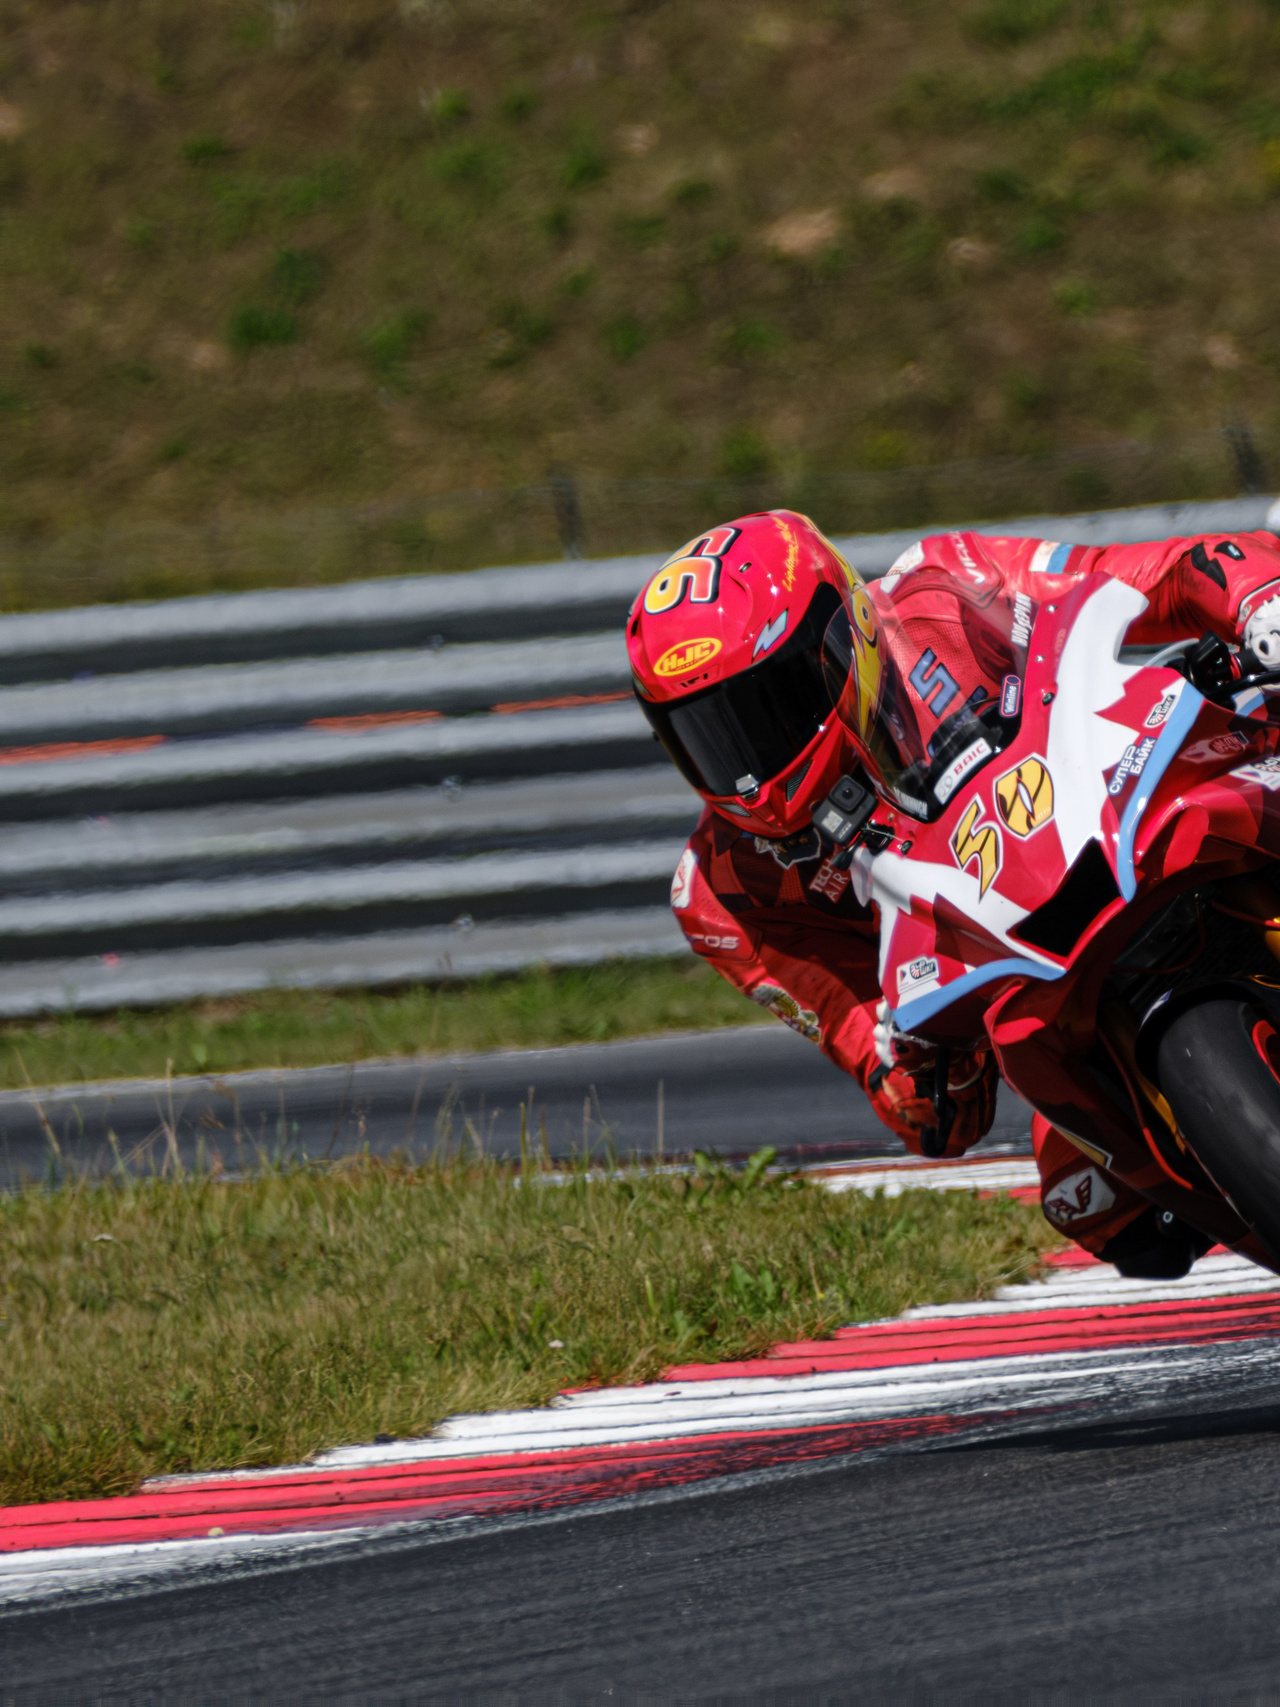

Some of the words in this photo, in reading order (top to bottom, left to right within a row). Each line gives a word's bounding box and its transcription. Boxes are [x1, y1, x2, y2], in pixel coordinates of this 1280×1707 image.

[662, 641, 712, 673] HJC
[953, 743, 988, 776] BAIC
[1108, 744, 1137, 794] СУПЕР
[1129, 737, 1156, 775] БАЙК
[949, 752, 1054, 901] 50
[826, 872, 848, 902] AIR
